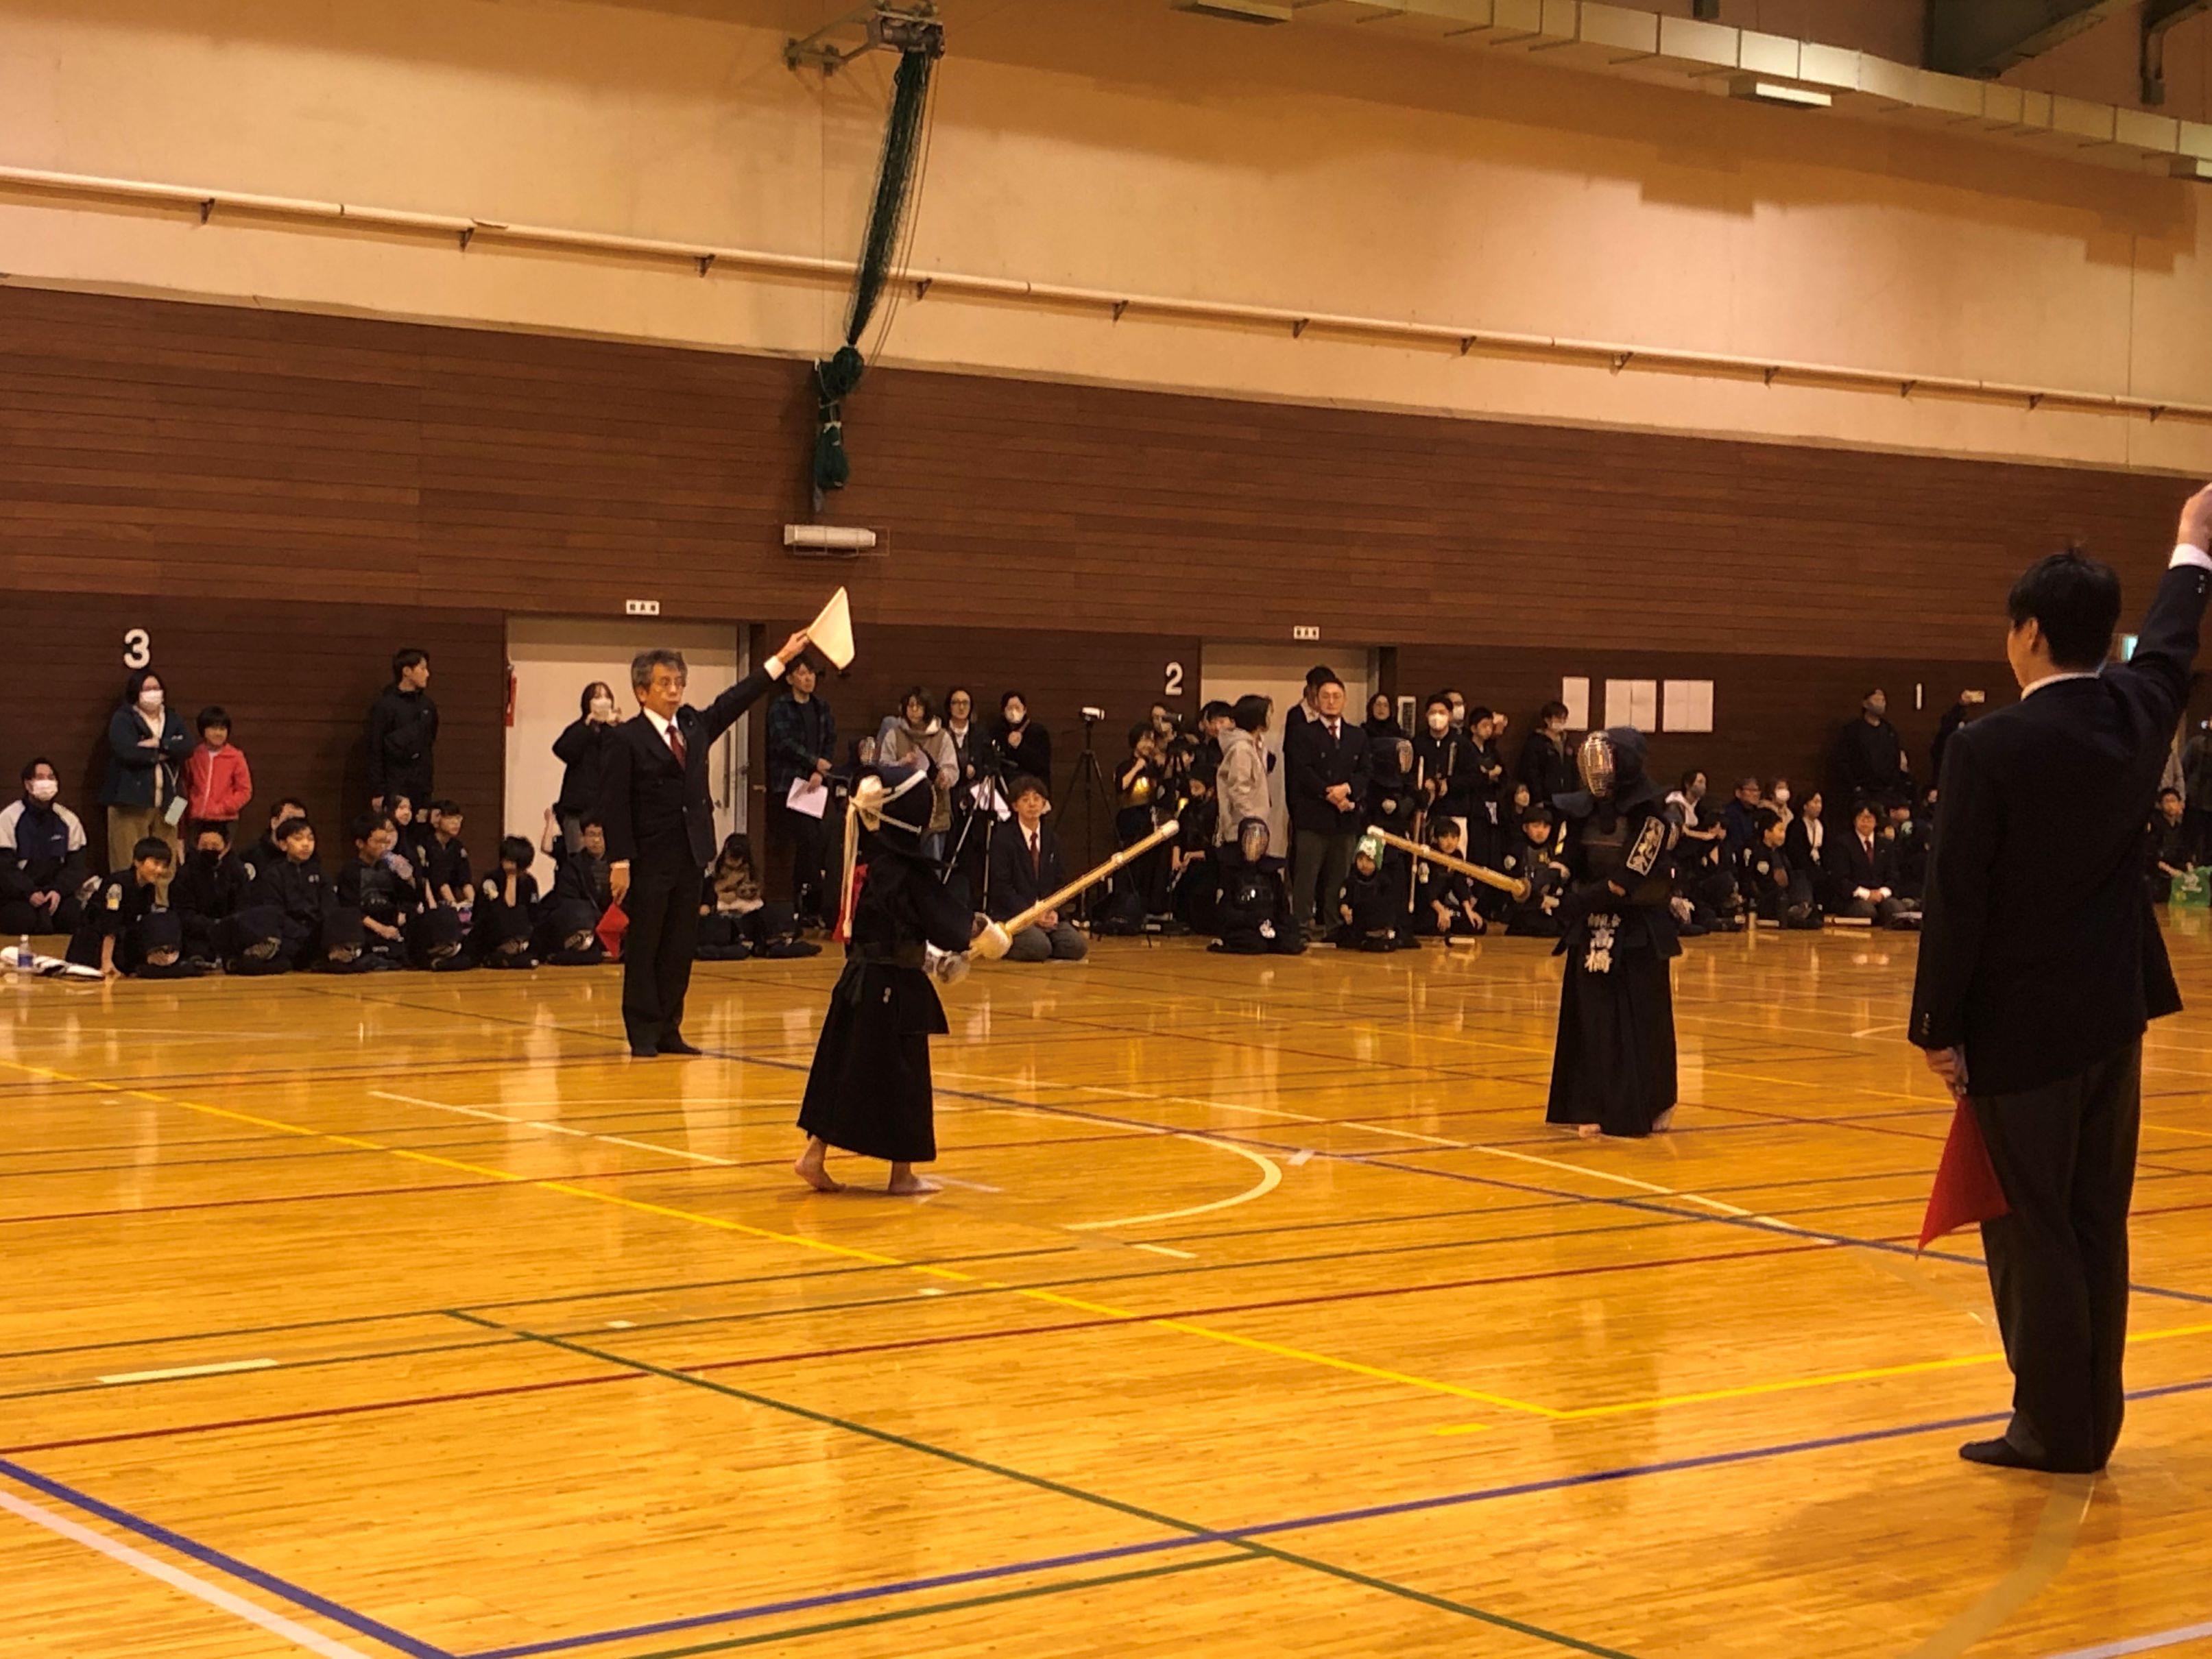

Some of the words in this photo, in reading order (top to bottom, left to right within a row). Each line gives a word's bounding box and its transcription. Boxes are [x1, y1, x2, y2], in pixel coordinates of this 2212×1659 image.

[124, 628, 150, 669] 3
[1165, 662, 1183, 696] 2
[1916, 683, 1923, 710] 1
